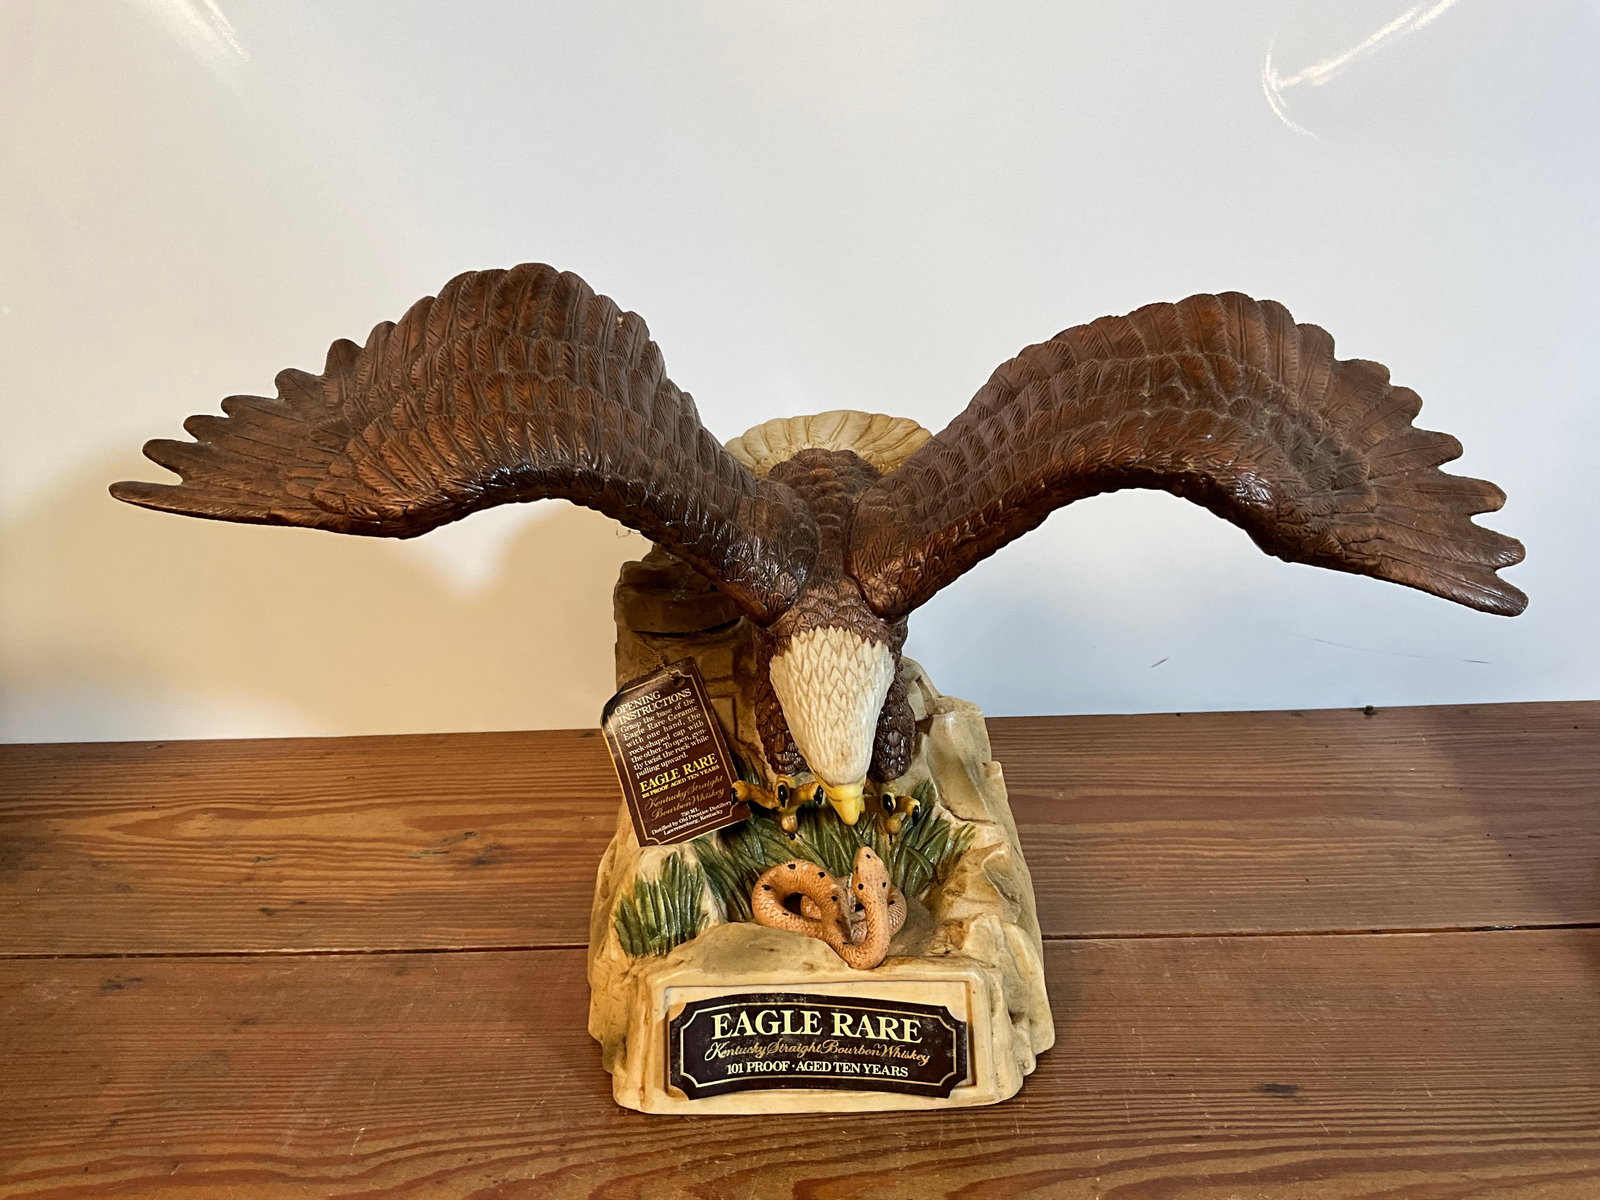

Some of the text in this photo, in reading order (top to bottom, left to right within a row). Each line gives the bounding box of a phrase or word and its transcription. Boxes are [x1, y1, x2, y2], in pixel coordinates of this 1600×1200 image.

[615, 691, 660, 716] OPENING
[619, 688, 692, 725] INSTRUCTIONS
[620, 698, 695, 733] Grasp the base of the
[623, 705, 698, 740] Eagle Rare Ceramic
[626, 713, 701, 748] with one hand, the
[629, 720, 704, 756] rock-shaped cap with
[631, 755, 643, 763] the
[643, 747, 663, 758] other.
[663, 741, 672, 749] To
[692, 728, 707, 739] gen-
[633, 735, 709, 771] tly twist the rock while
[636, 751, 688, 780] pulling upward.
[639, 753, 718, 793] EAGLE RARE
[650, 784, 669, 796] PROOF
[670, 777, 687, 788] AGED
[686, 772, 699, 780] TEN
[699, 764, 720, 776] YEARS
[645, 775, 723, 810] Kentucky Straight
[651, 788, 725, 821] Bourbon Whiskey
[651, 822, 672, 835] Distilled
[711, 1010, 923, 1043] EAGLE RARE
[704, 1037, 931, 1067] Kentucky Straight Bourbon Whiskey
[726, 1060, 909, 1077] 101 PROOF AGED TEN YEARS
